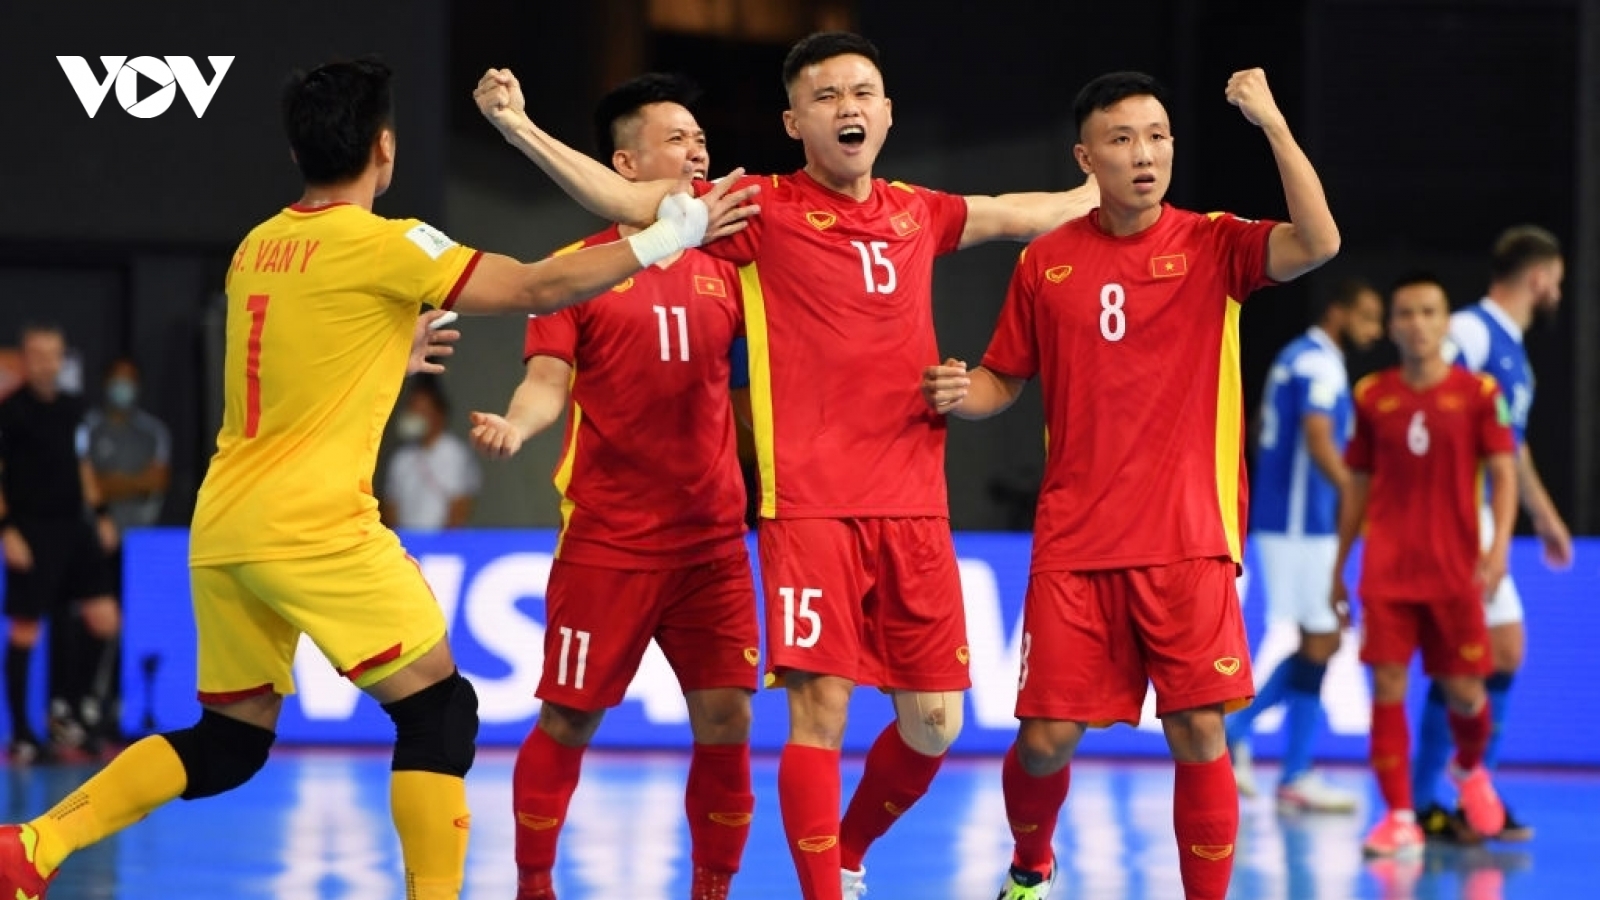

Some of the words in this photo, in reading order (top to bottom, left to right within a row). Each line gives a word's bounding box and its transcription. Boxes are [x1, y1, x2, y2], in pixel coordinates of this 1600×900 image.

[300, 238, 320, 274] Y
[850, 240, 897, 295] 15
[652, 304, 690, 362] 11
[1099, 283, 1126, 342] 8
[245, 294, 270, 439] 1
[1407, 410, 1430, 456] 6
[779, 587, 822, 648] 15
[557, 626, 591, 690] 11
